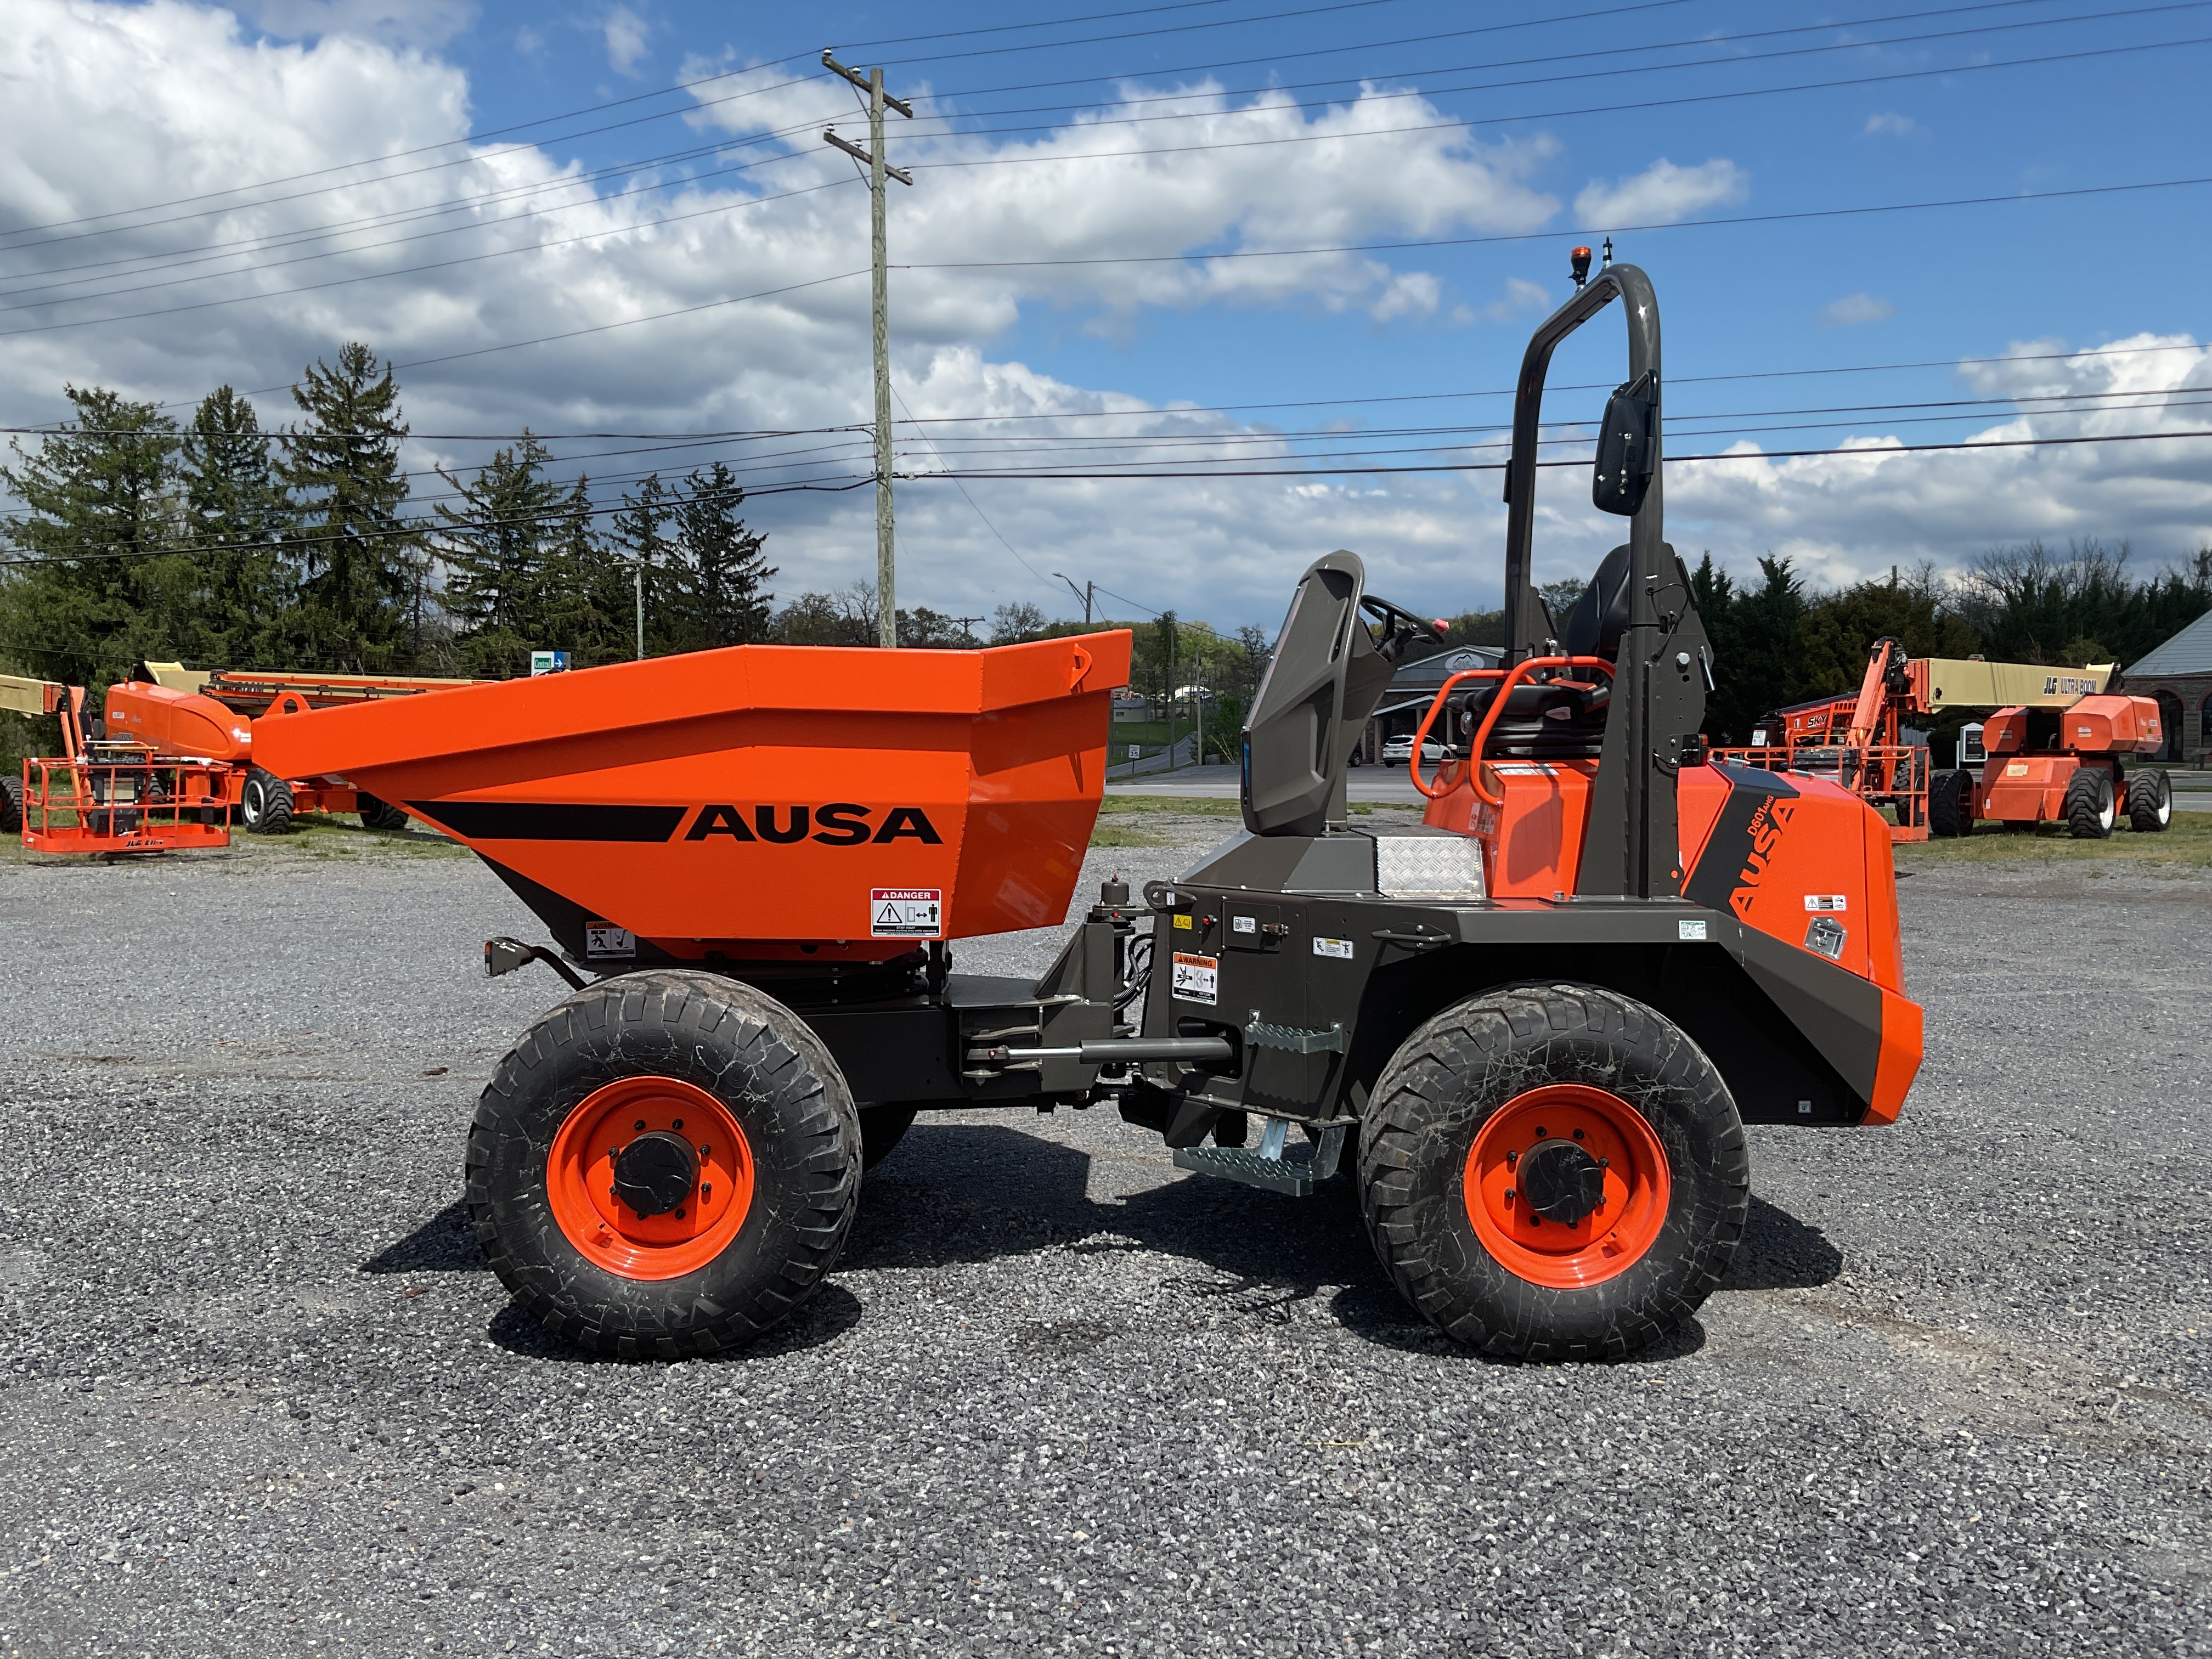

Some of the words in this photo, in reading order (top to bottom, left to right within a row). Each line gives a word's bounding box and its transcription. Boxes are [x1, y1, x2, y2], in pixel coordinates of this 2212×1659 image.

[535, 659, 551, 668] Central
[2044, 676, 2057, 695] JLG
[2061, 677, 2078, 695] ULTRA
[2080, 679, 2096, 695] BOOM
[1808, 714, 1827, 727] SKY
[683, 803, 944, 846] AUSA
[1728, 798, 1799, 922] AUSA
[1183, 957, 1212, 967] WARNING
